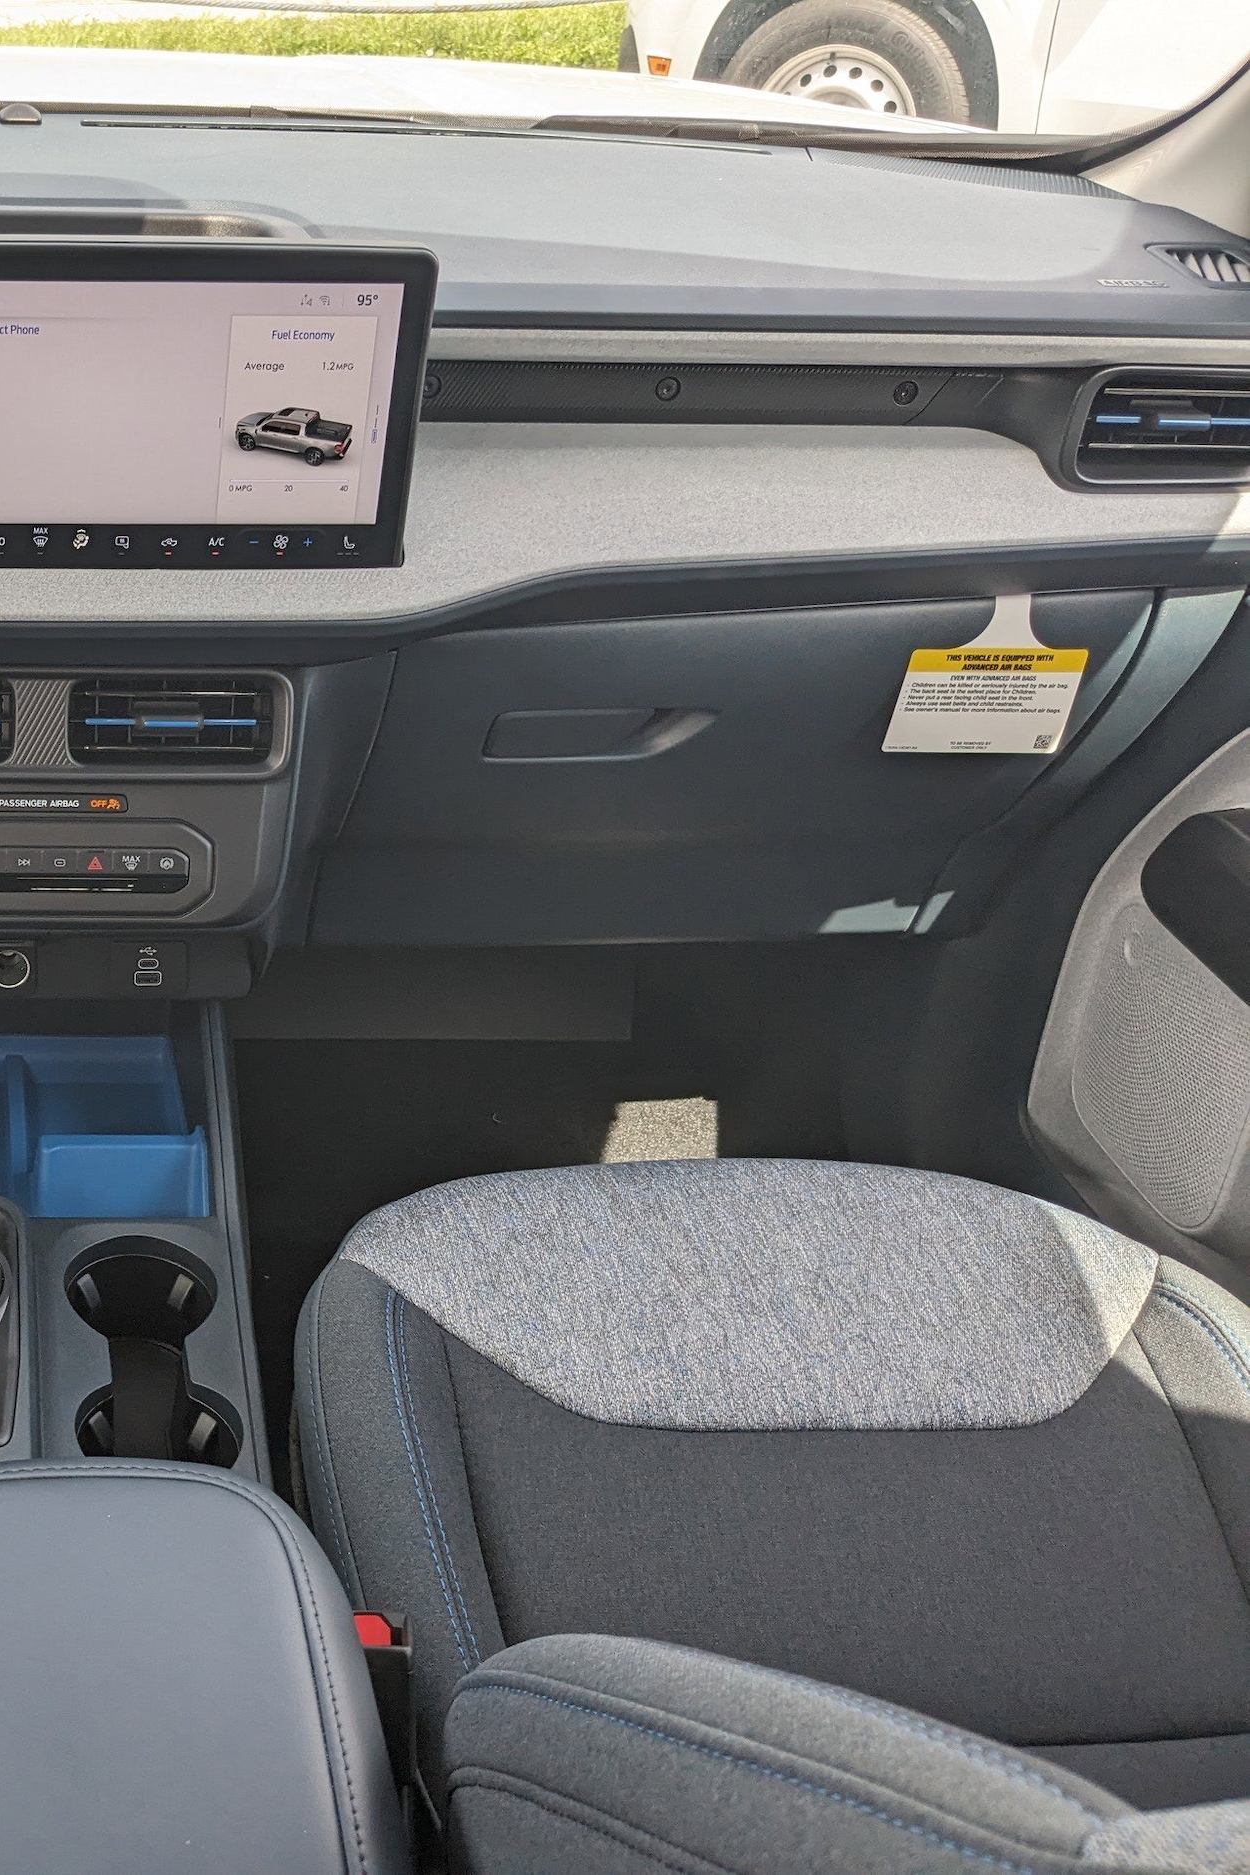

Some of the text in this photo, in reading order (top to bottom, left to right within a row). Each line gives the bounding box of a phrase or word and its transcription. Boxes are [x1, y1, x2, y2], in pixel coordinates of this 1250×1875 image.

[356, 294, 379, 306] 95°
[10, 324, 40, 335] Phone
[271, 330, 336, 342] Fuel Economy
[244, 361, 285, 372] Average
[32, 527, 49, 535] MAX
[208, 537, 225, 547] A/C
[49, 799, 80, 808] AIRBAG
[90, 799, 108, 808] OFF
[121, 855, 141, 863] MAX
